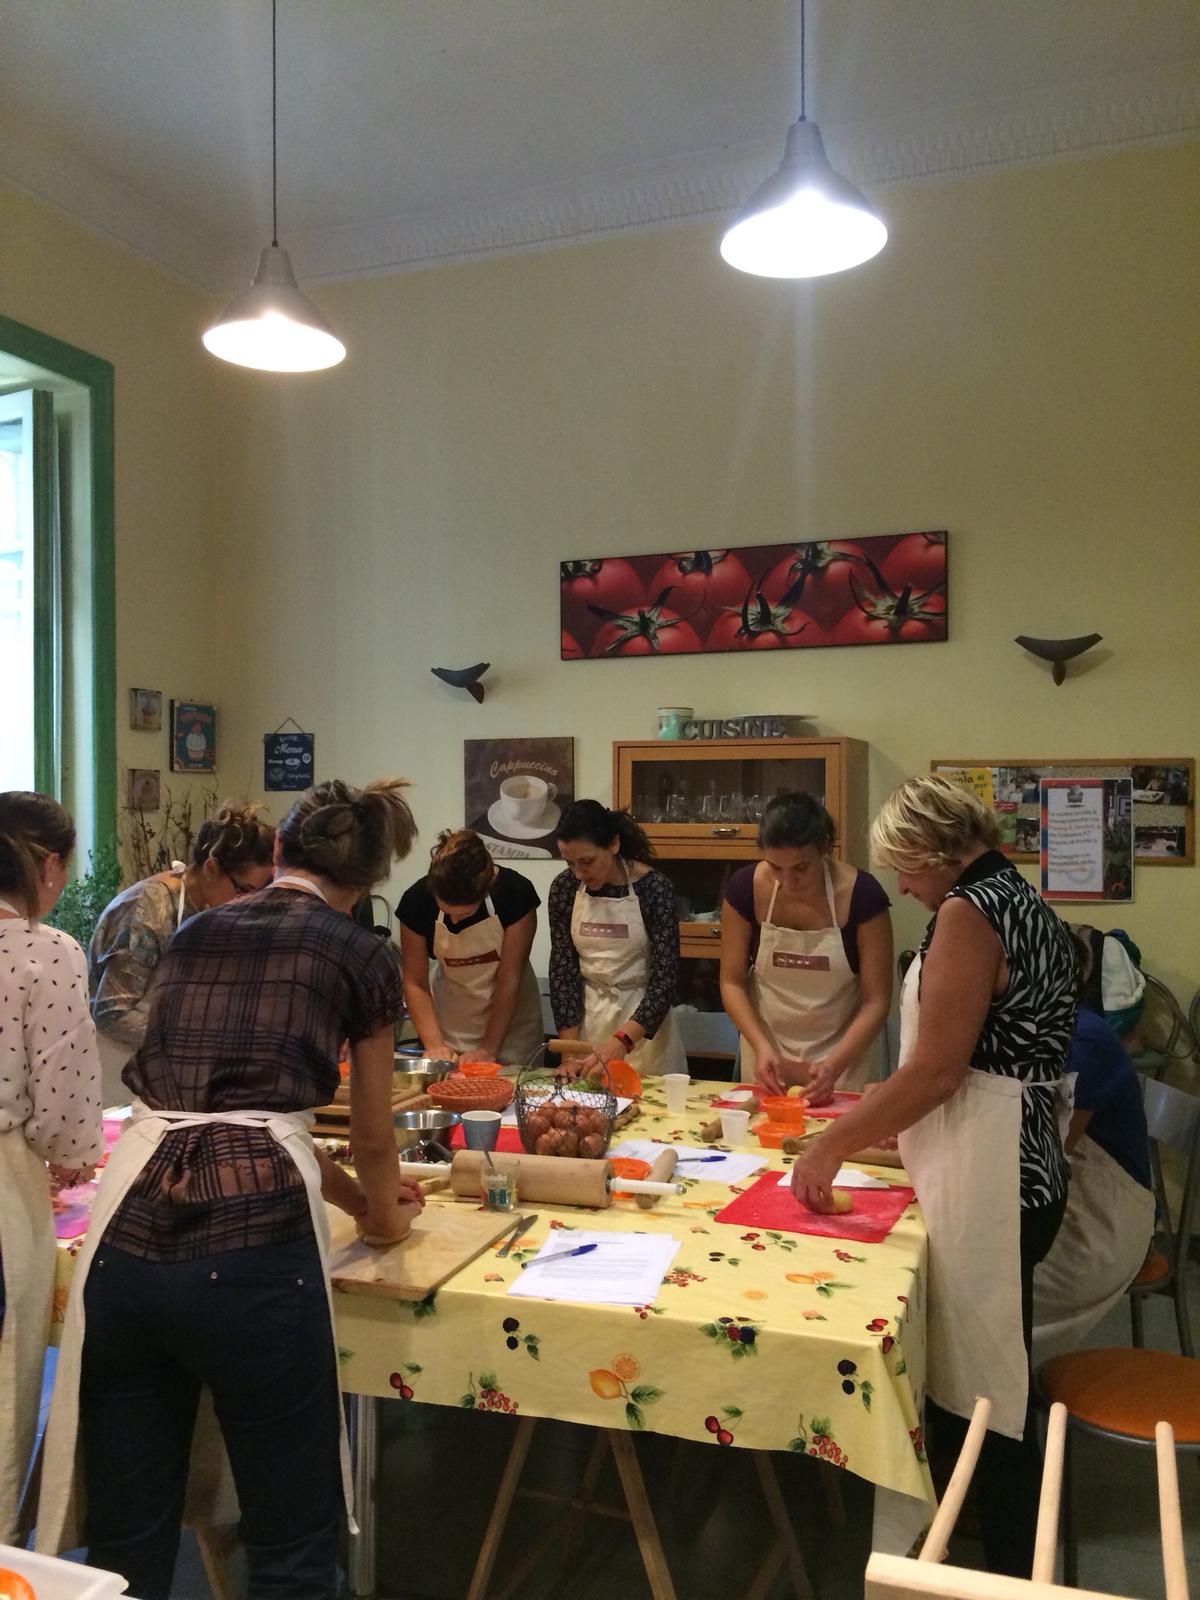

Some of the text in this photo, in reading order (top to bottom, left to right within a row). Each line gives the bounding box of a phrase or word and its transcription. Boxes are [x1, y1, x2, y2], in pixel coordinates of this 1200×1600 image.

[679, 718, 785, 740] CUISINE
[274, 743, 304, 754] Menu
[490, 759, 560, 778] Cappuccino
